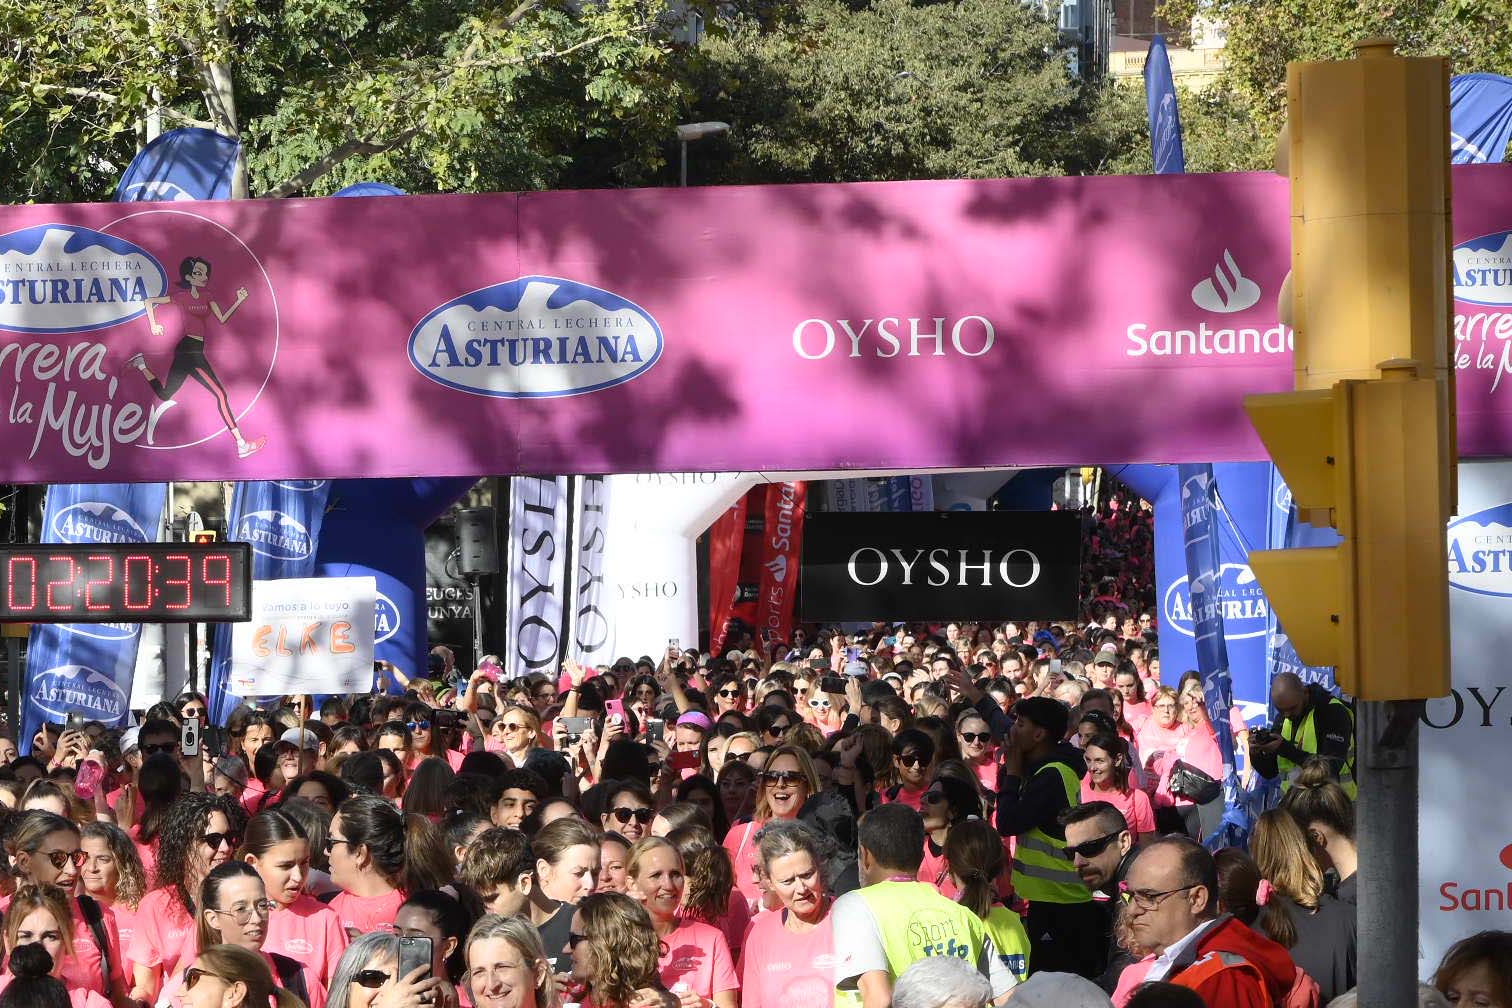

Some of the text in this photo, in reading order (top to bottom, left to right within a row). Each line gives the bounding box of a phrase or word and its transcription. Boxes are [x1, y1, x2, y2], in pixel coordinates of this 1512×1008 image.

[70, 260, 144, 272] LECHERA
[428, 323, 644, 368] ASTURIANA
[467, 317, 635, 333] CENTRAL LECHERA
[792, 315, 996, 360] OYSHO
[9, 386, 33, 424] la
[27, 375, 178, 470] Mujer
[8, 555, 231, 610] 02:20:39
[847, 547, 1041, 588] OYSHO
[252, 621, 356, 657] ELKE
[35, 680, 120, 715] ASTURIANA
